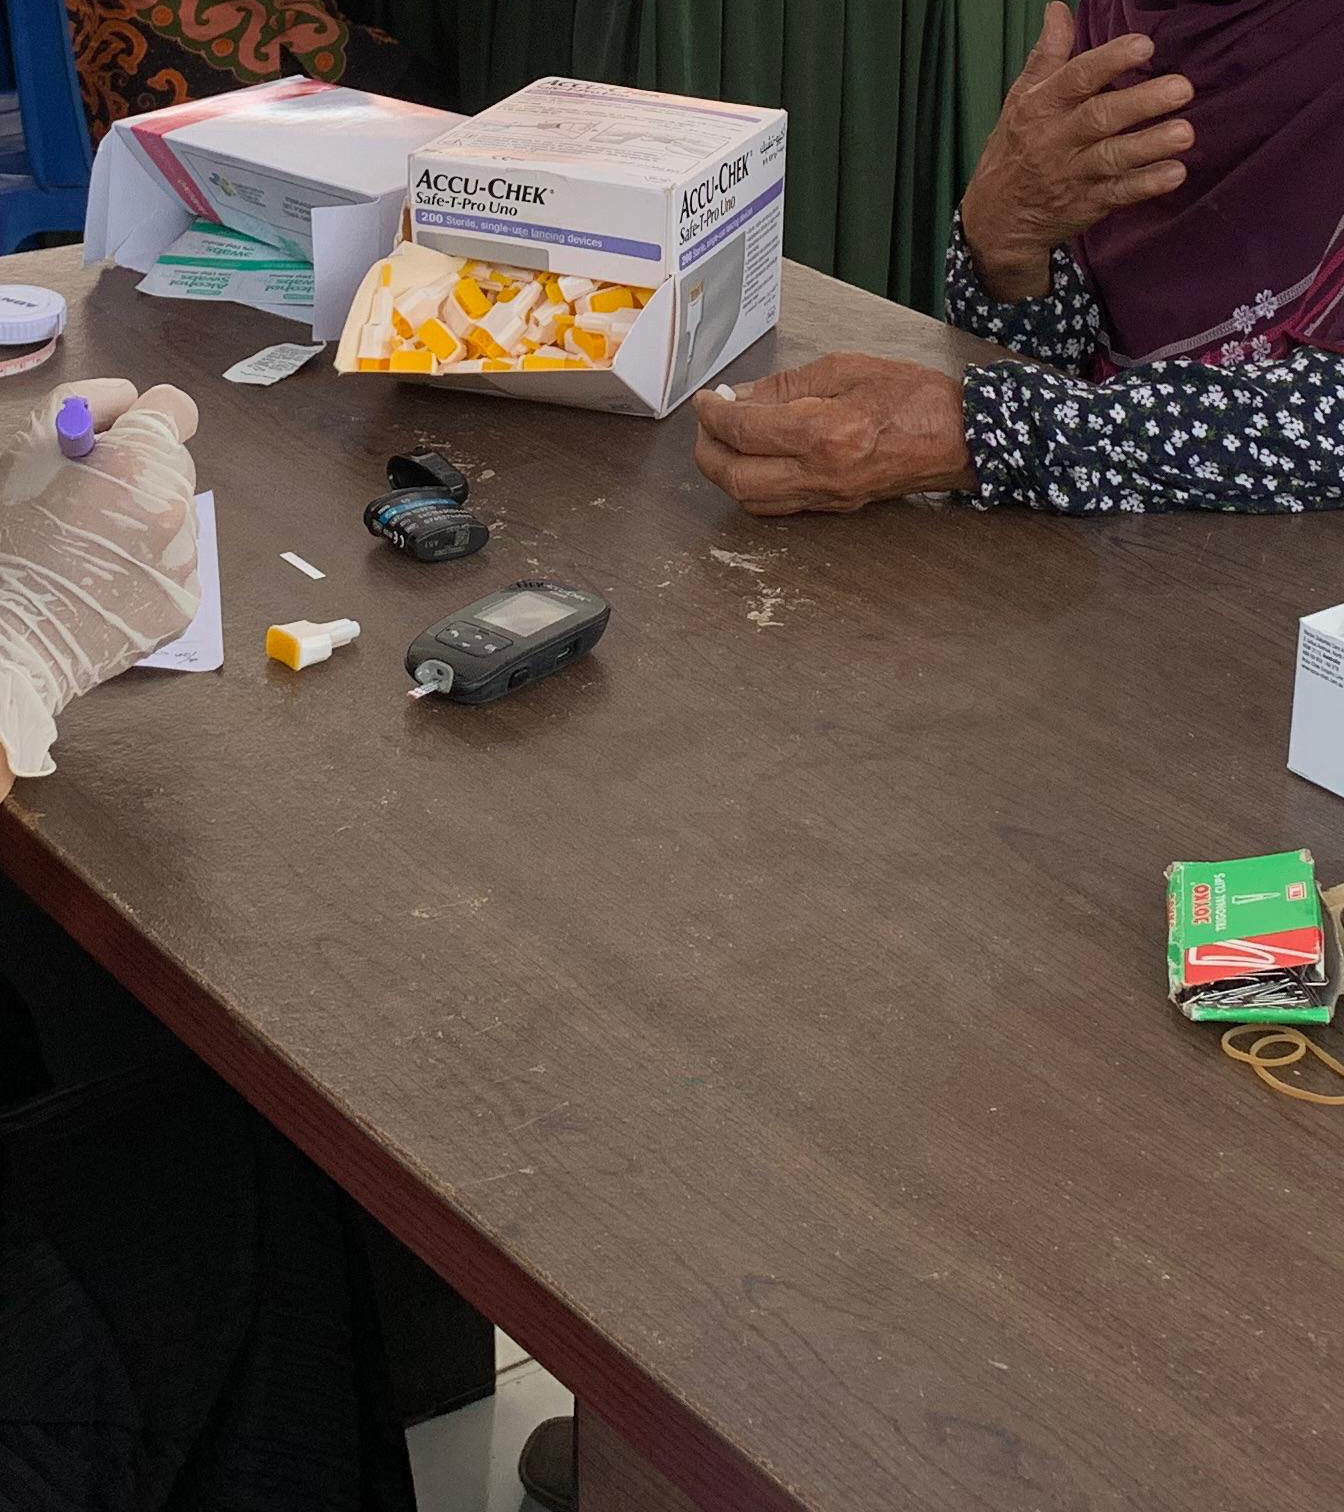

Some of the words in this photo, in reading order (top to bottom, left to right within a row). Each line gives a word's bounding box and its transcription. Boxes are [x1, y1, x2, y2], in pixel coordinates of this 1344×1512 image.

[415, 168, 548, 206] ACCU-CHEK
[415, 191, 487, 213] Safe-T-Pro
[489, 202, 518, 217] Uno
[680, 151, 750, 224] ACCU-CHEK
[421, 211, 444, 225] 200
[567, 234, 604, 249] devices
[679, 207, 720, 246] Safe-T-Pro
[265, 282, 314, 293] lcohol
[1213, 872, 1227, 893] CLIPS
[1192, 883, 1211, 925] JOYKO
